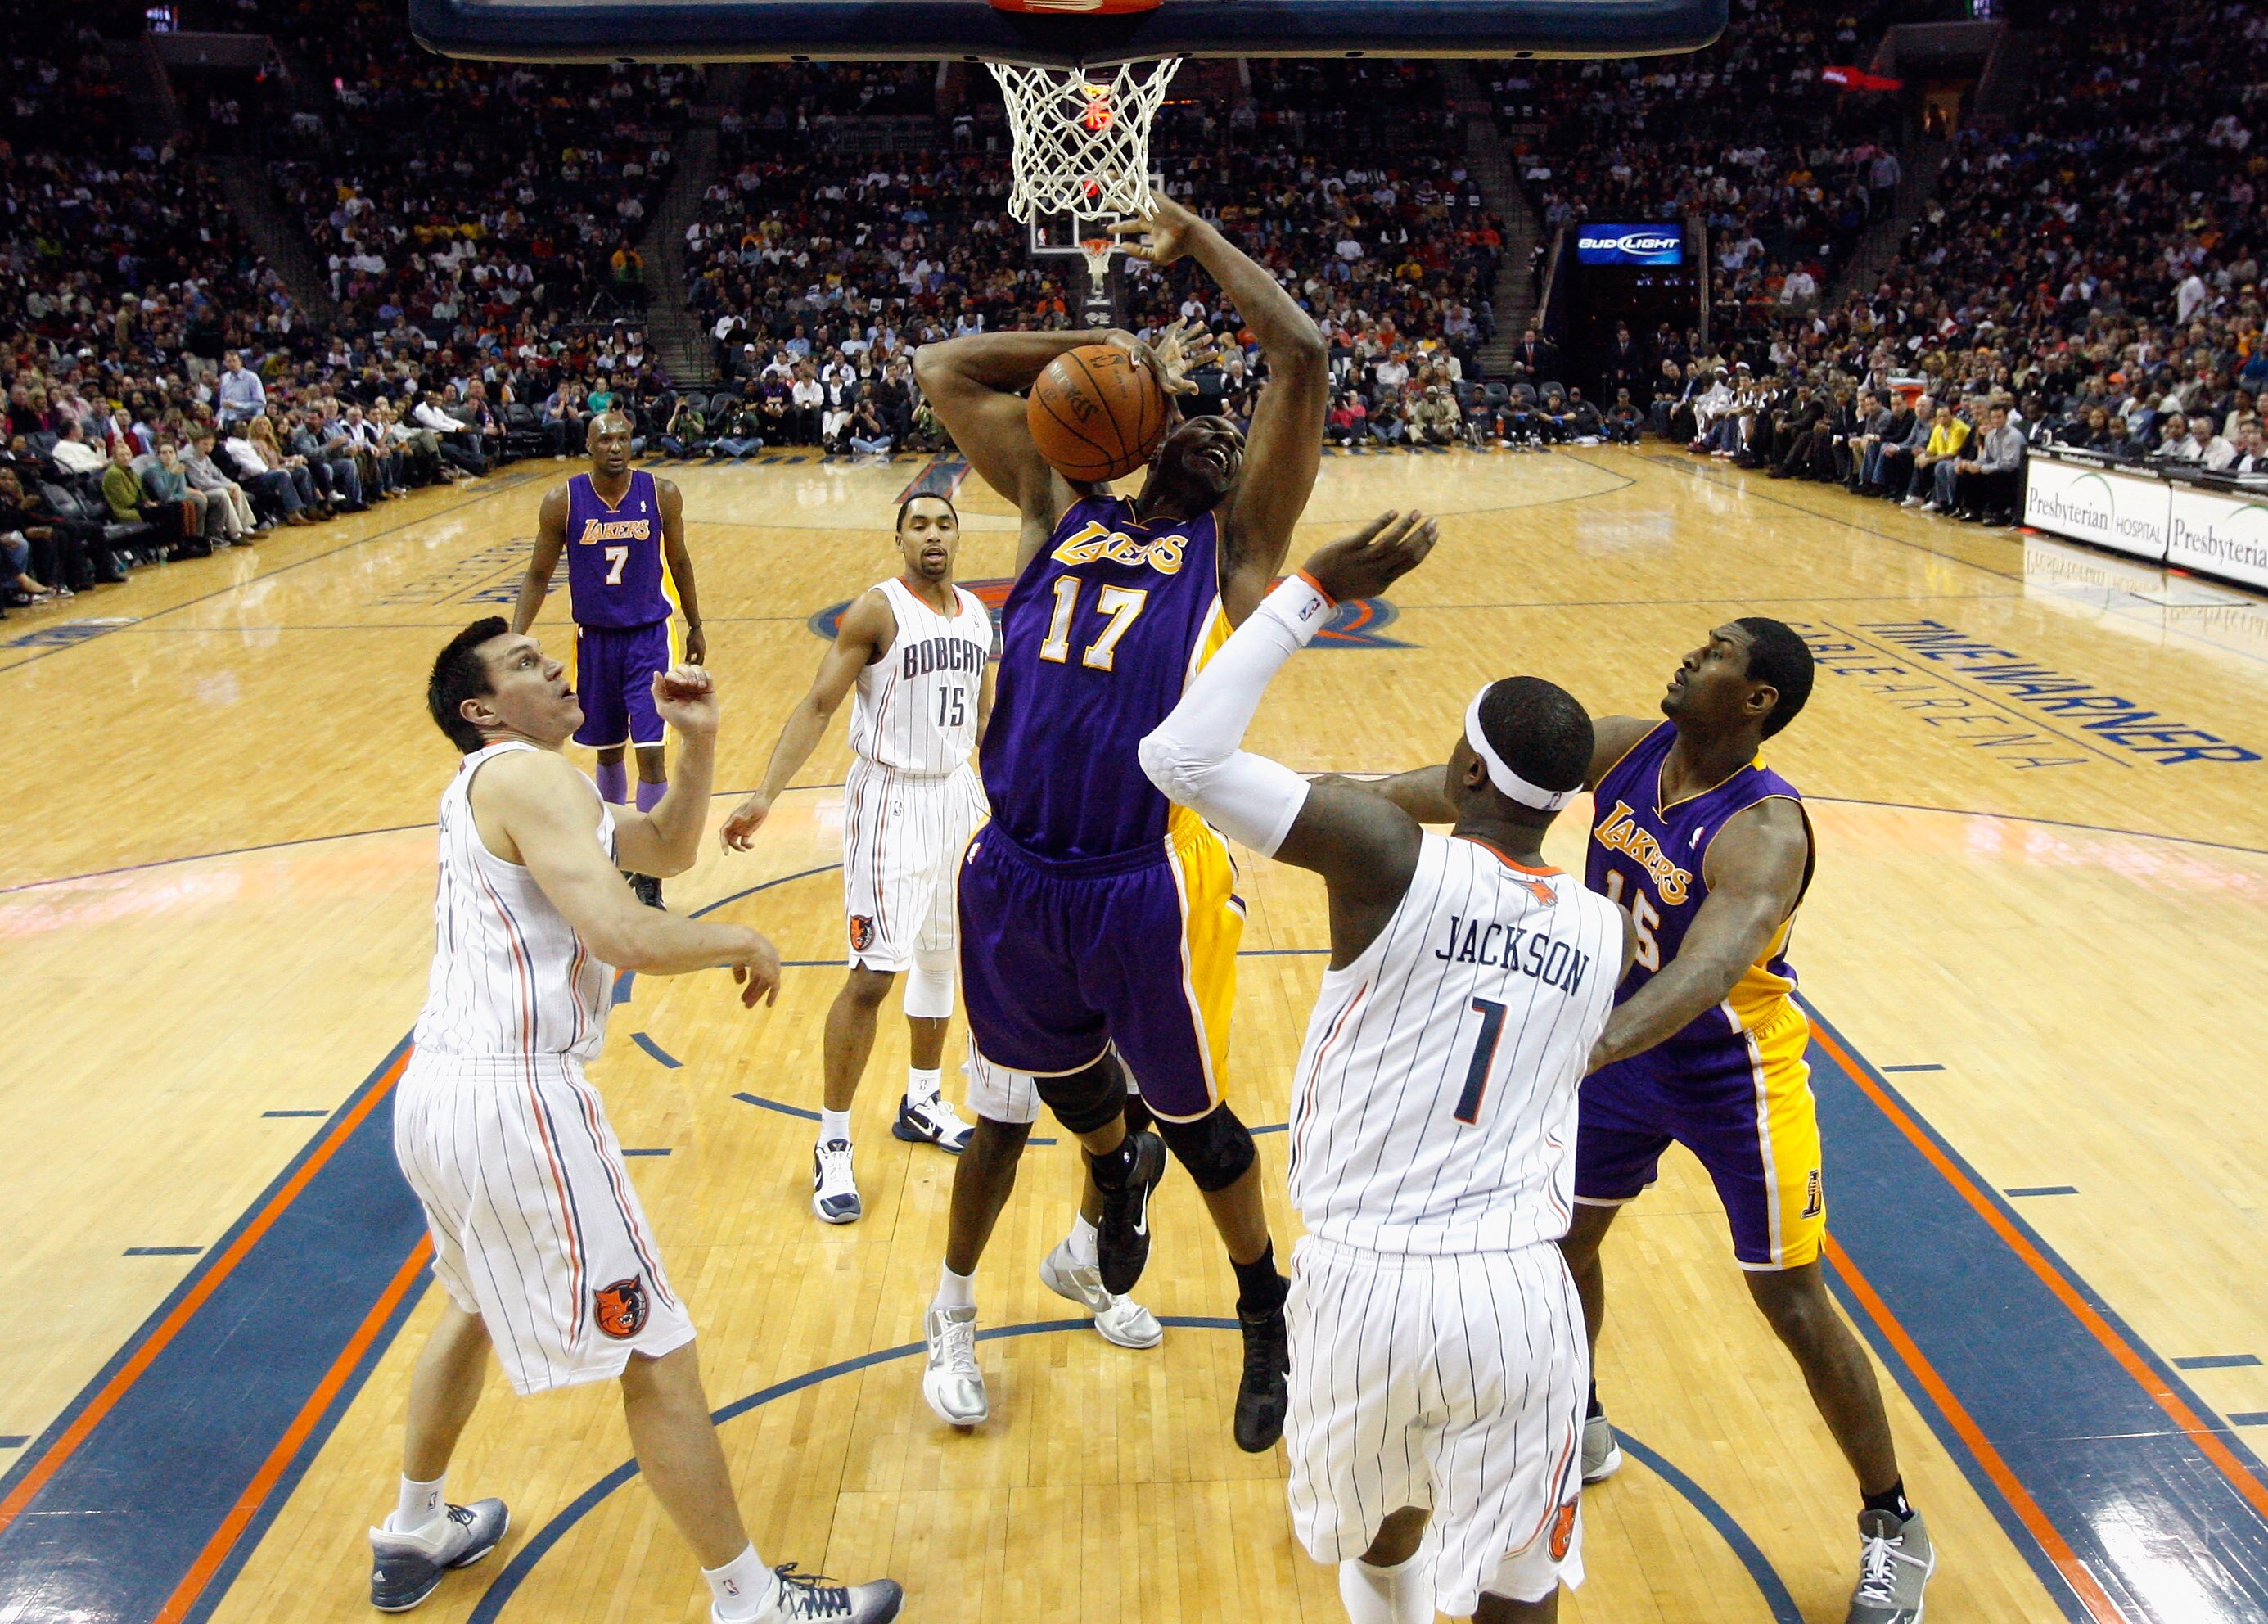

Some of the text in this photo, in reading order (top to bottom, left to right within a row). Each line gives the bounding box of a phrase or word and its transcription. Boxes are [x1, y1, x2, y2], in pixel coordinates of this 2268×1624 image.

[1578, 238, 1680, 249] BUD LIGHT
[579, 518, 651, 545] LAKERS
[2027, 486, 2162, 544] Presbyterian HOSPITAL
[604, 545, 629, 585] 7
[1039, 574, 1148, 672] 17
[938, 686, 965, 727] 15
[1594, 799, 1693, 906] LAKERS
[1435, 915, 1590, 997] JACKSON
[1453, 995, 1508, 1126] 1
